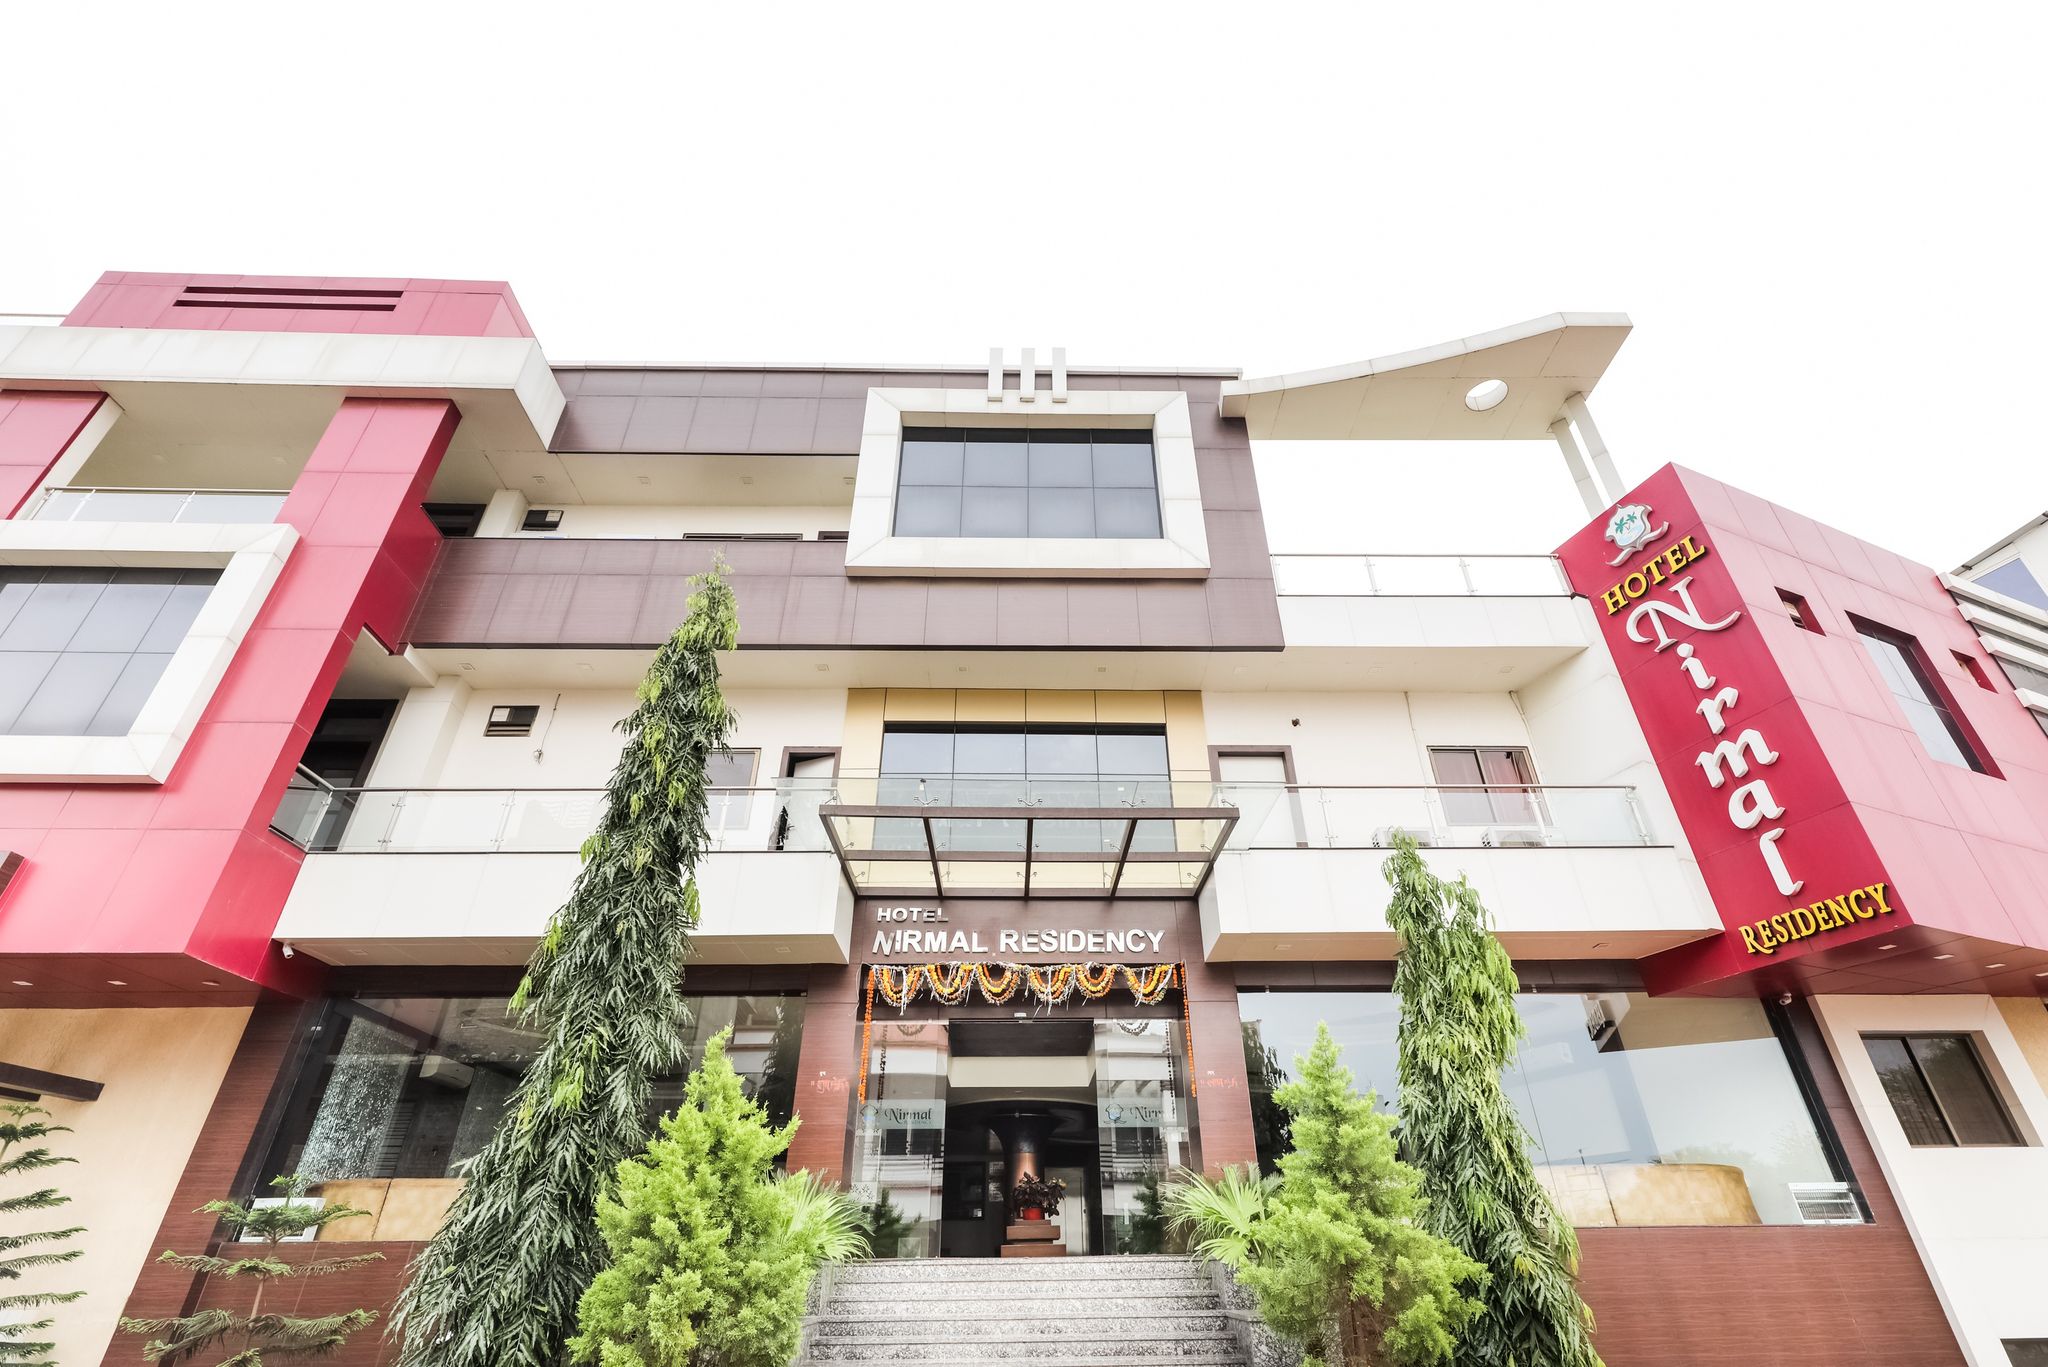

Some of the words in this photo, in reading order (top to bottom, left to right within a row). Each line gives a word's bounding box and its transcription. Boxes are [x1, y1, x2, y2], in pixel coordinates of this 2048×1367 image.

[1601, 535, 1706, 616] HOTEL
[1626, 576, 1804, 896] Nirmal
[877, 907, 949, 922] HOTEL
[1738, 882, 1892, 954] RESIDENCY
[872, 929, 989, 957] NIRMAL
[1000, 928, 1166, 954] RESIDENCY
[884, 1107, 932, 1124] Nirmal
